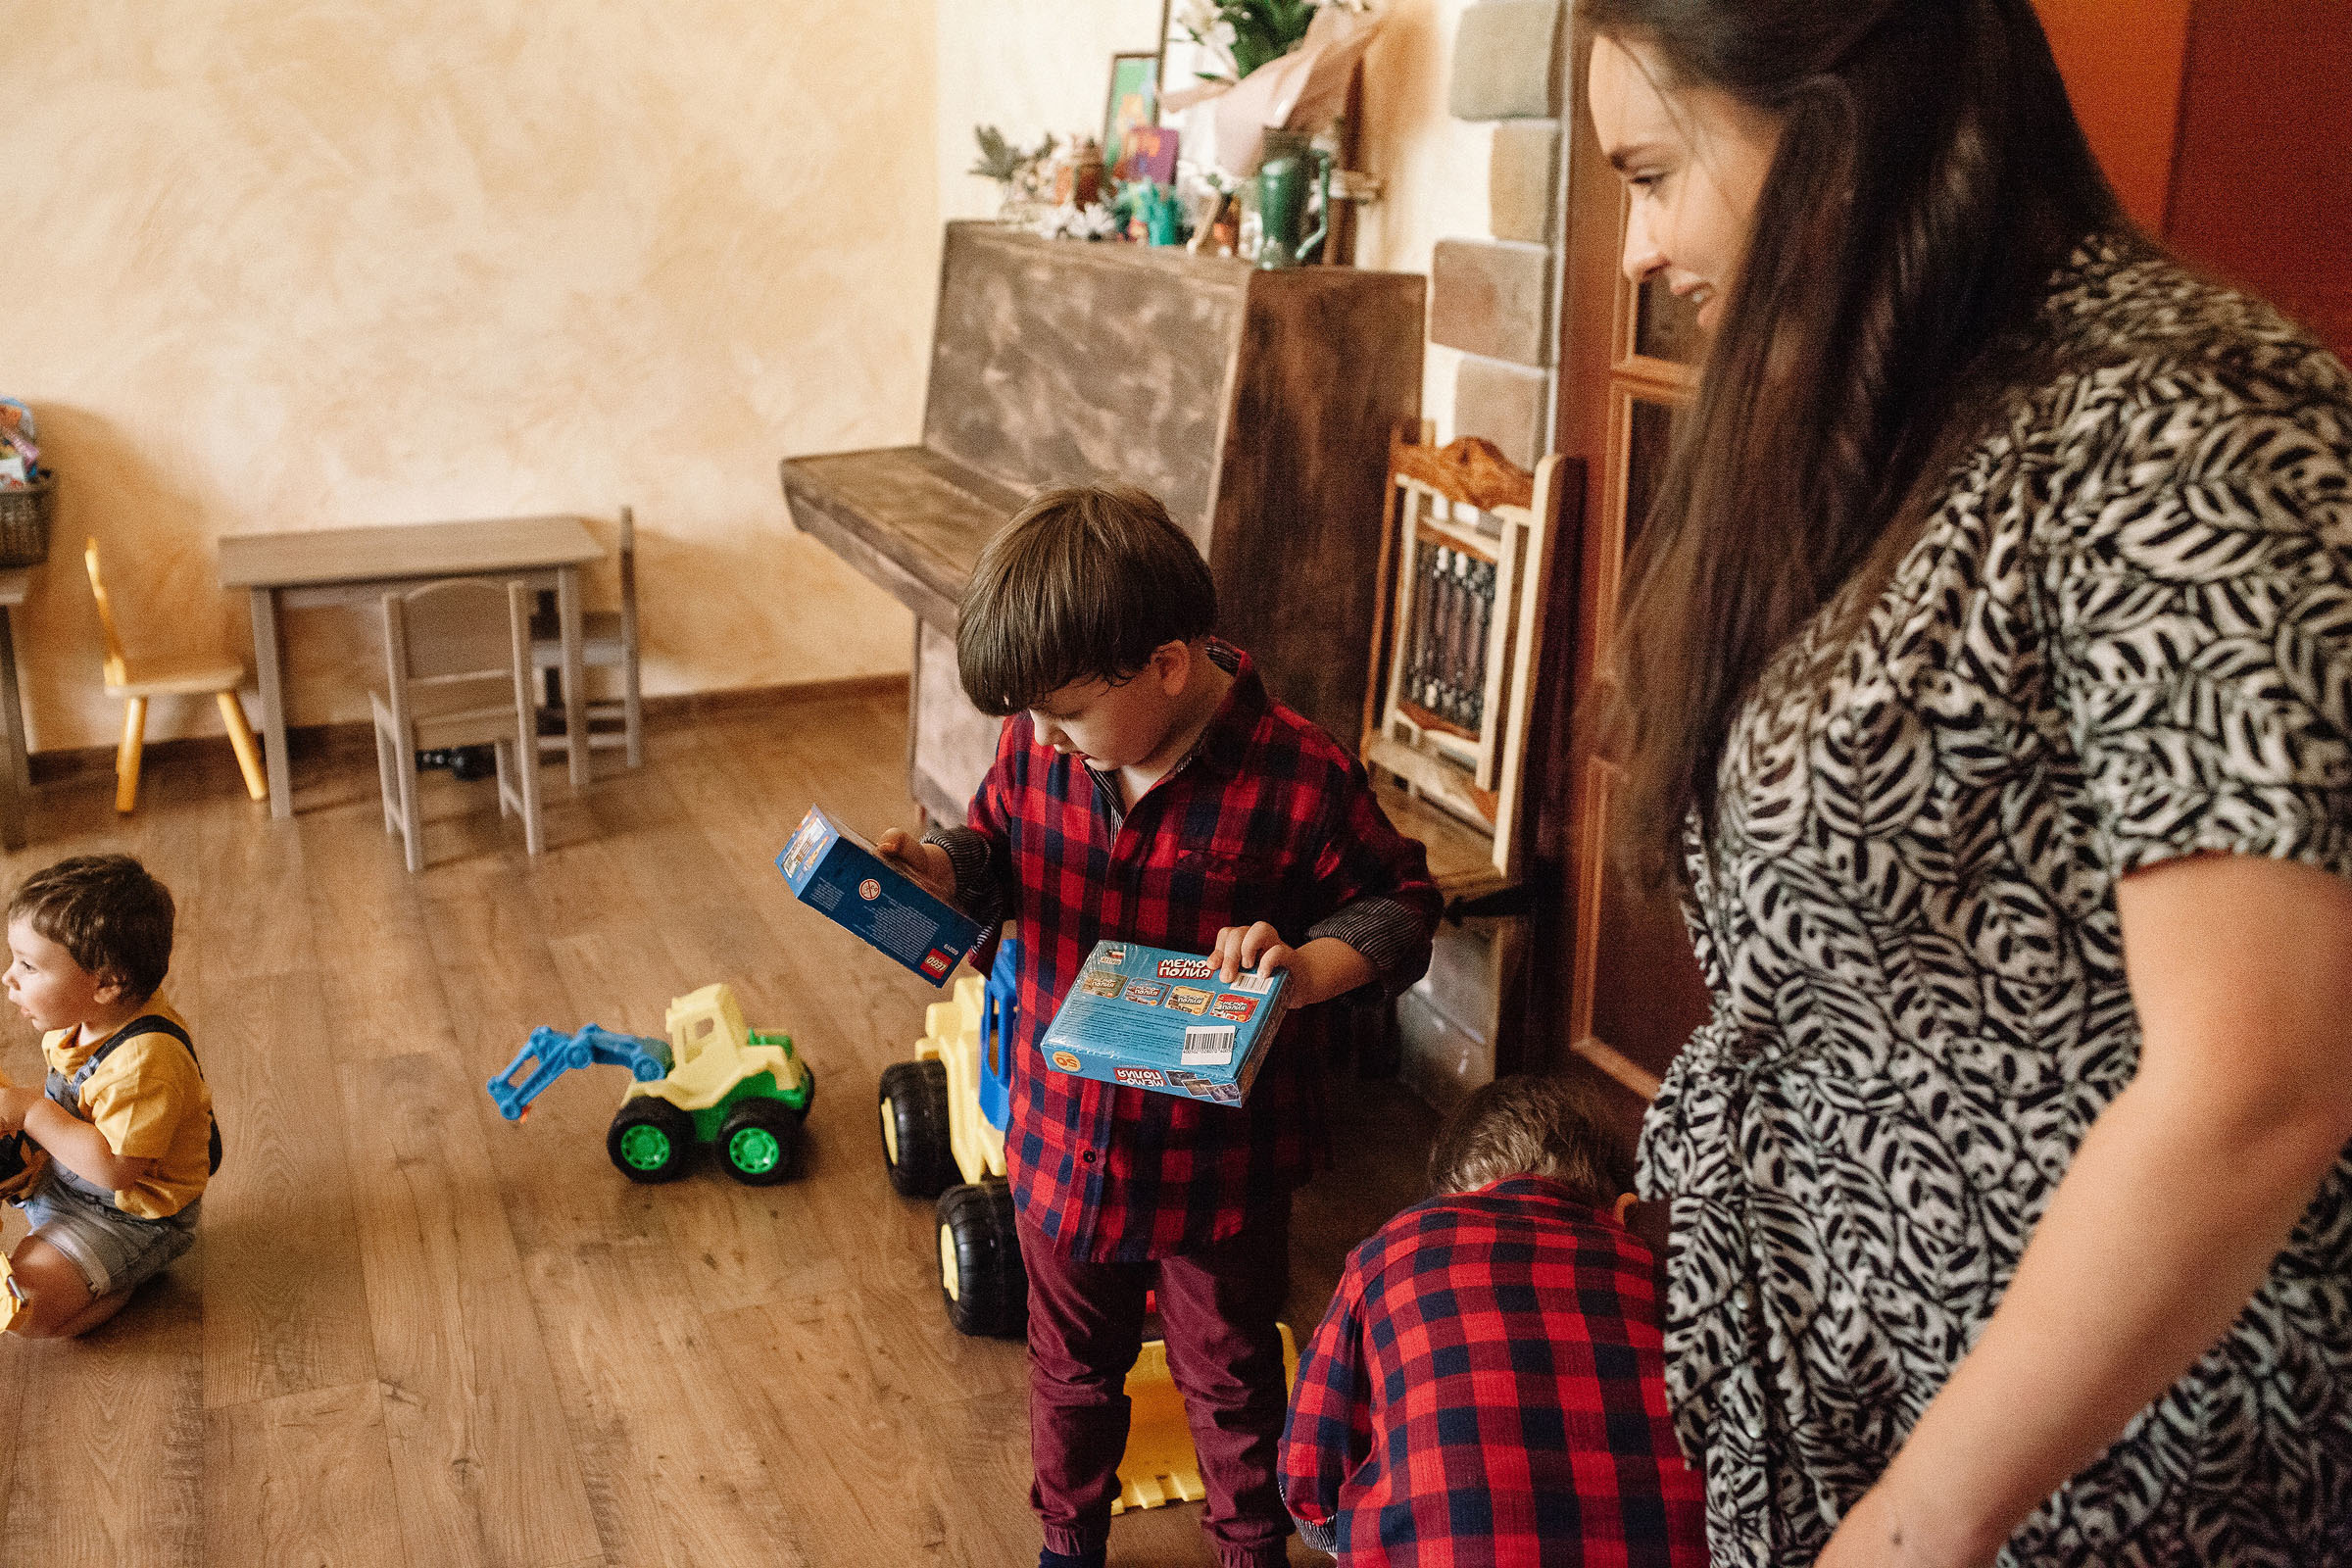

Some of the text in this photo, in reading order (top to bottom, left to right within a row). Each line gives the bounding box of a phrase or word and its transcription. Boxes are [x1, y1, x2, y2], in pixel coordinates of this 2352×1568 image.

[927, 956, 947, 971] LEGO
[1159, 967, 1211, 978] ПОЛИЯ
[1055, 1056, 1078, 1068] 50
[1117, 1069, 1160, 1078] ПОЛИЯ
